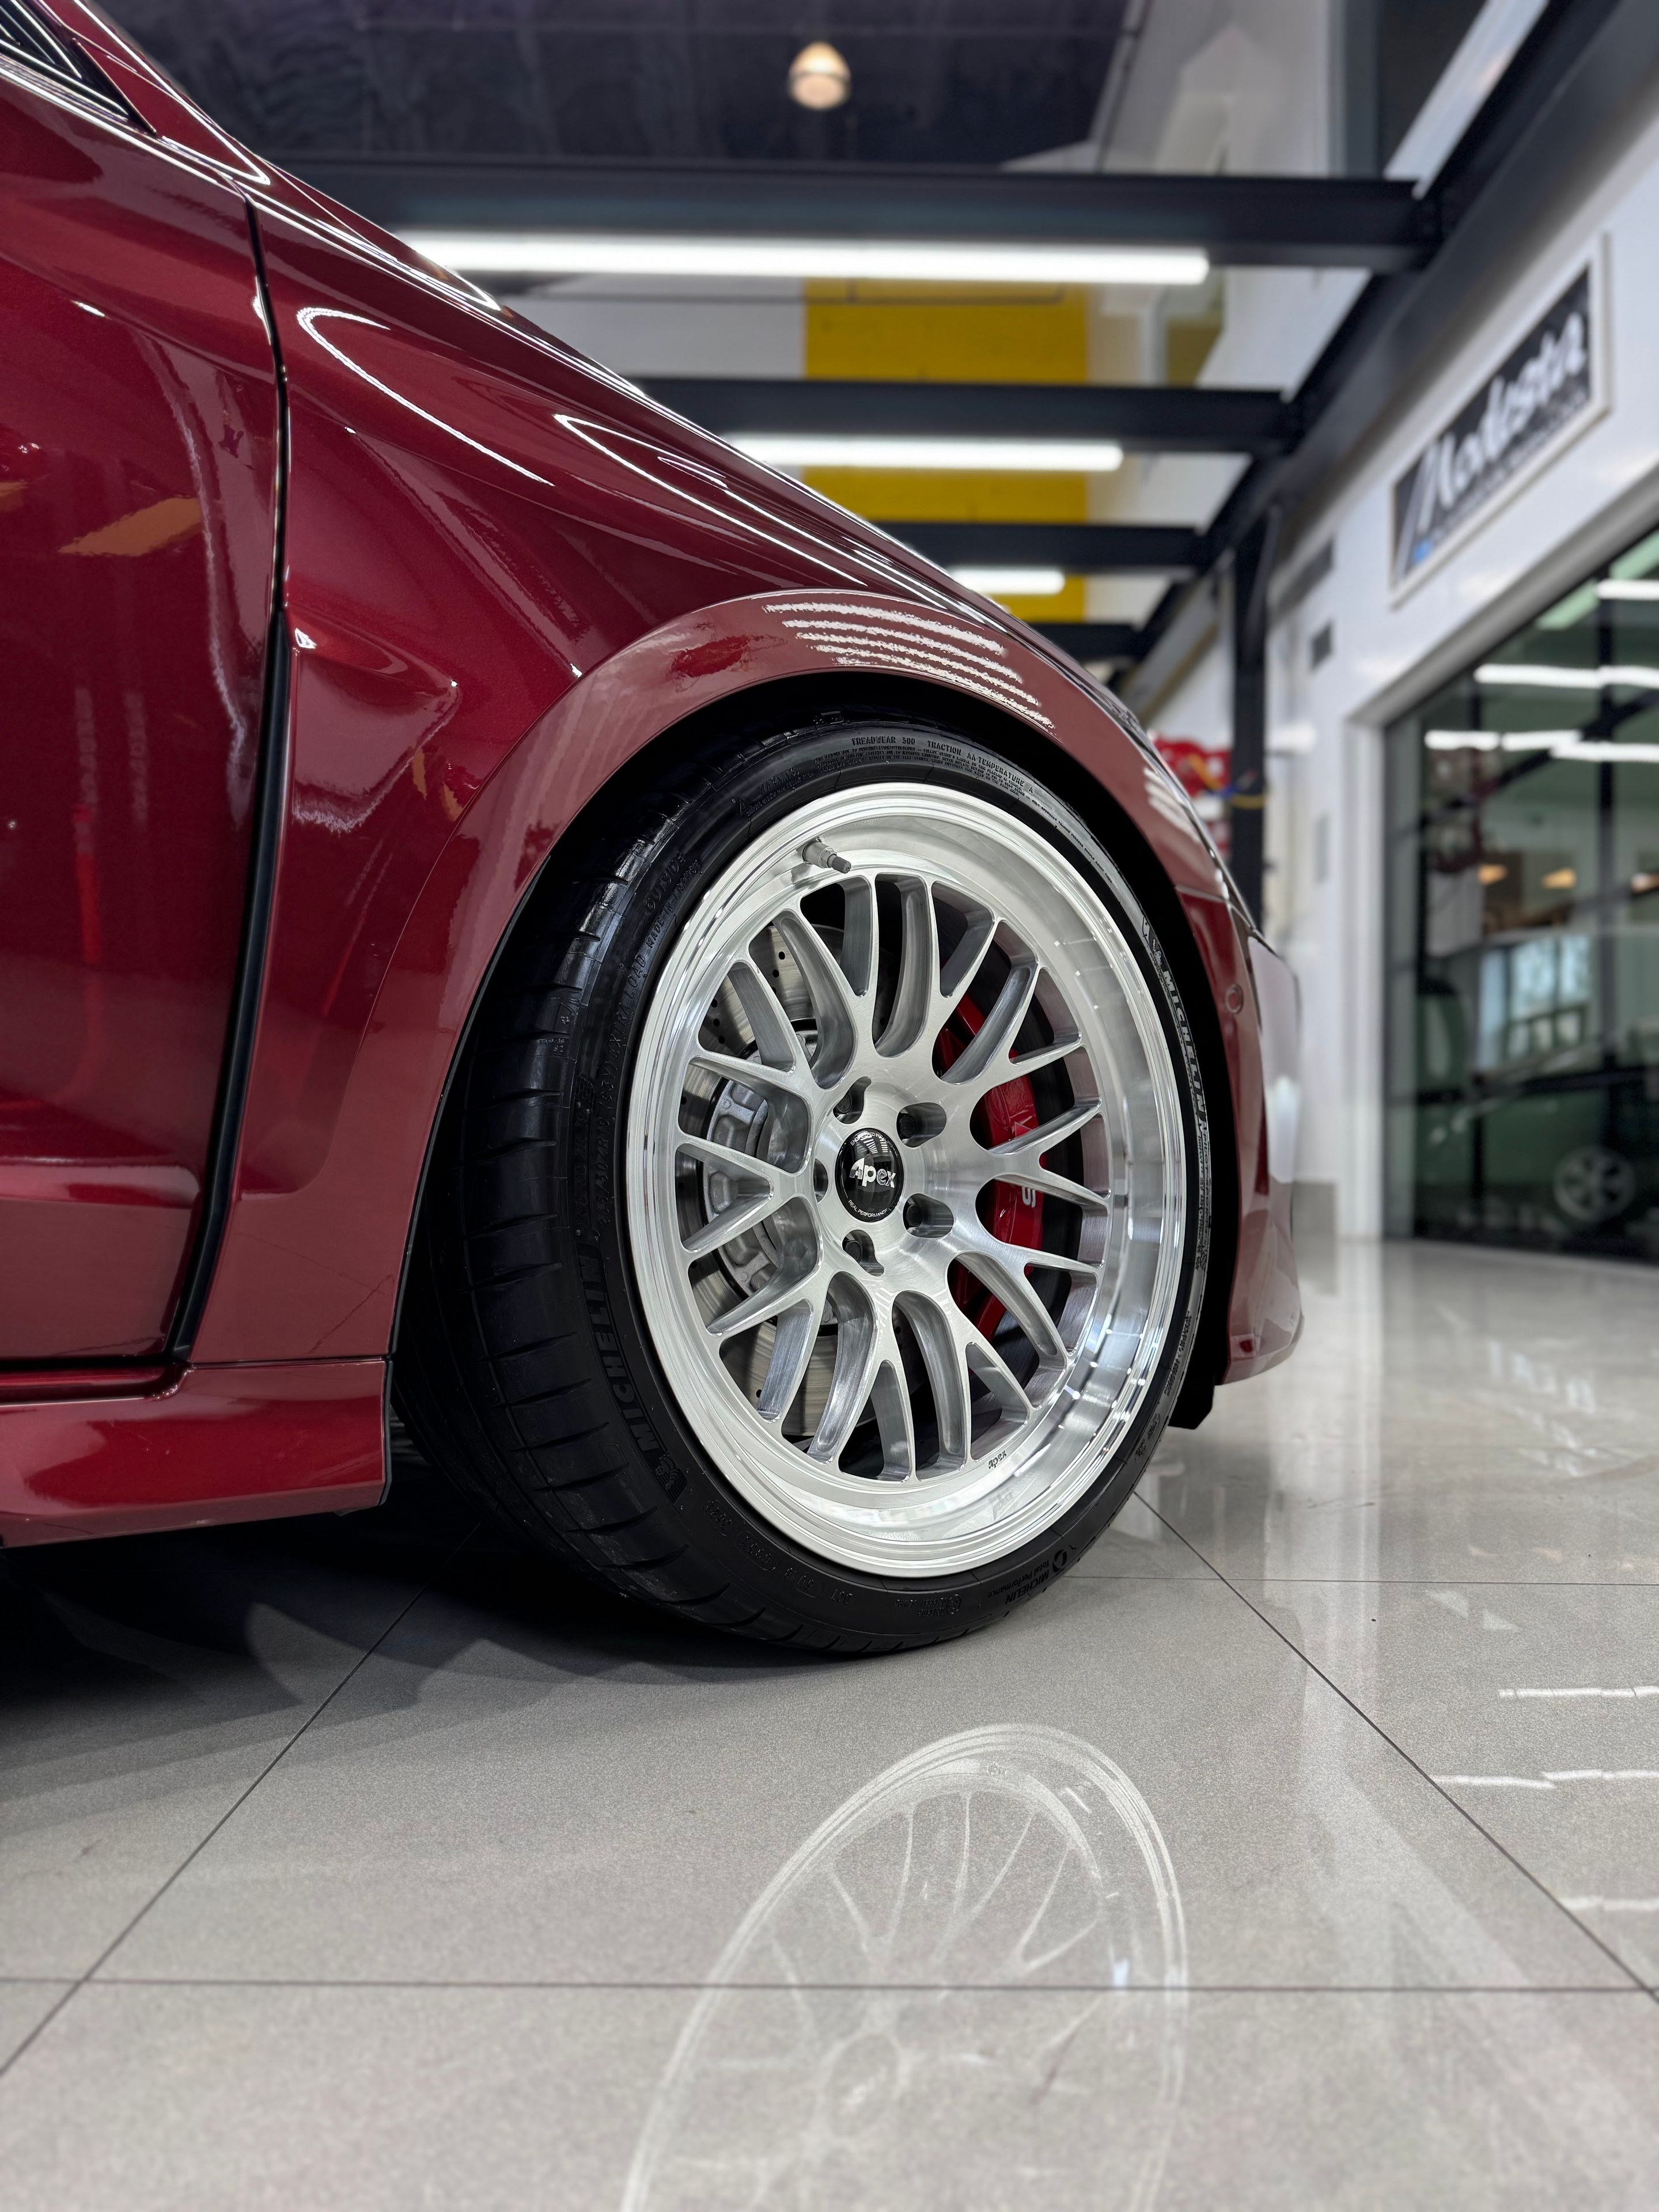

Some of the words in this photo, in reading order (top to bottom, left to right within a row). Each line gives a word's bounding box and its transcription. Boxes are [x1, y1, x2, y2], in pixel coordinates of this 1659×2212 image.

[851, 736, 896, 746] TREADWEAR
[902, 737, 915, 745] 300
[927, 740, 961, 756] TRACTION
[967, 752, 976, 762] AA
[979, 756, 1025, 787] TEMPERATURE
[645, 851, 687, 911] OUTSIDE
[623, 953, 646, 999] LOAD
[1161, 969, 1205, 1113] MICHELIN
[849, 1158, 896, 1188] Apex
[848, 1199, 857, 1212] REAL
[579, 1256, 661, 1452] MICHELIN
[987, 1570, 1033, 1599] Performance
[1005, 1569, 1049, 1605] MICHELIN
[1032, 1559, 1049, 1576] Total
